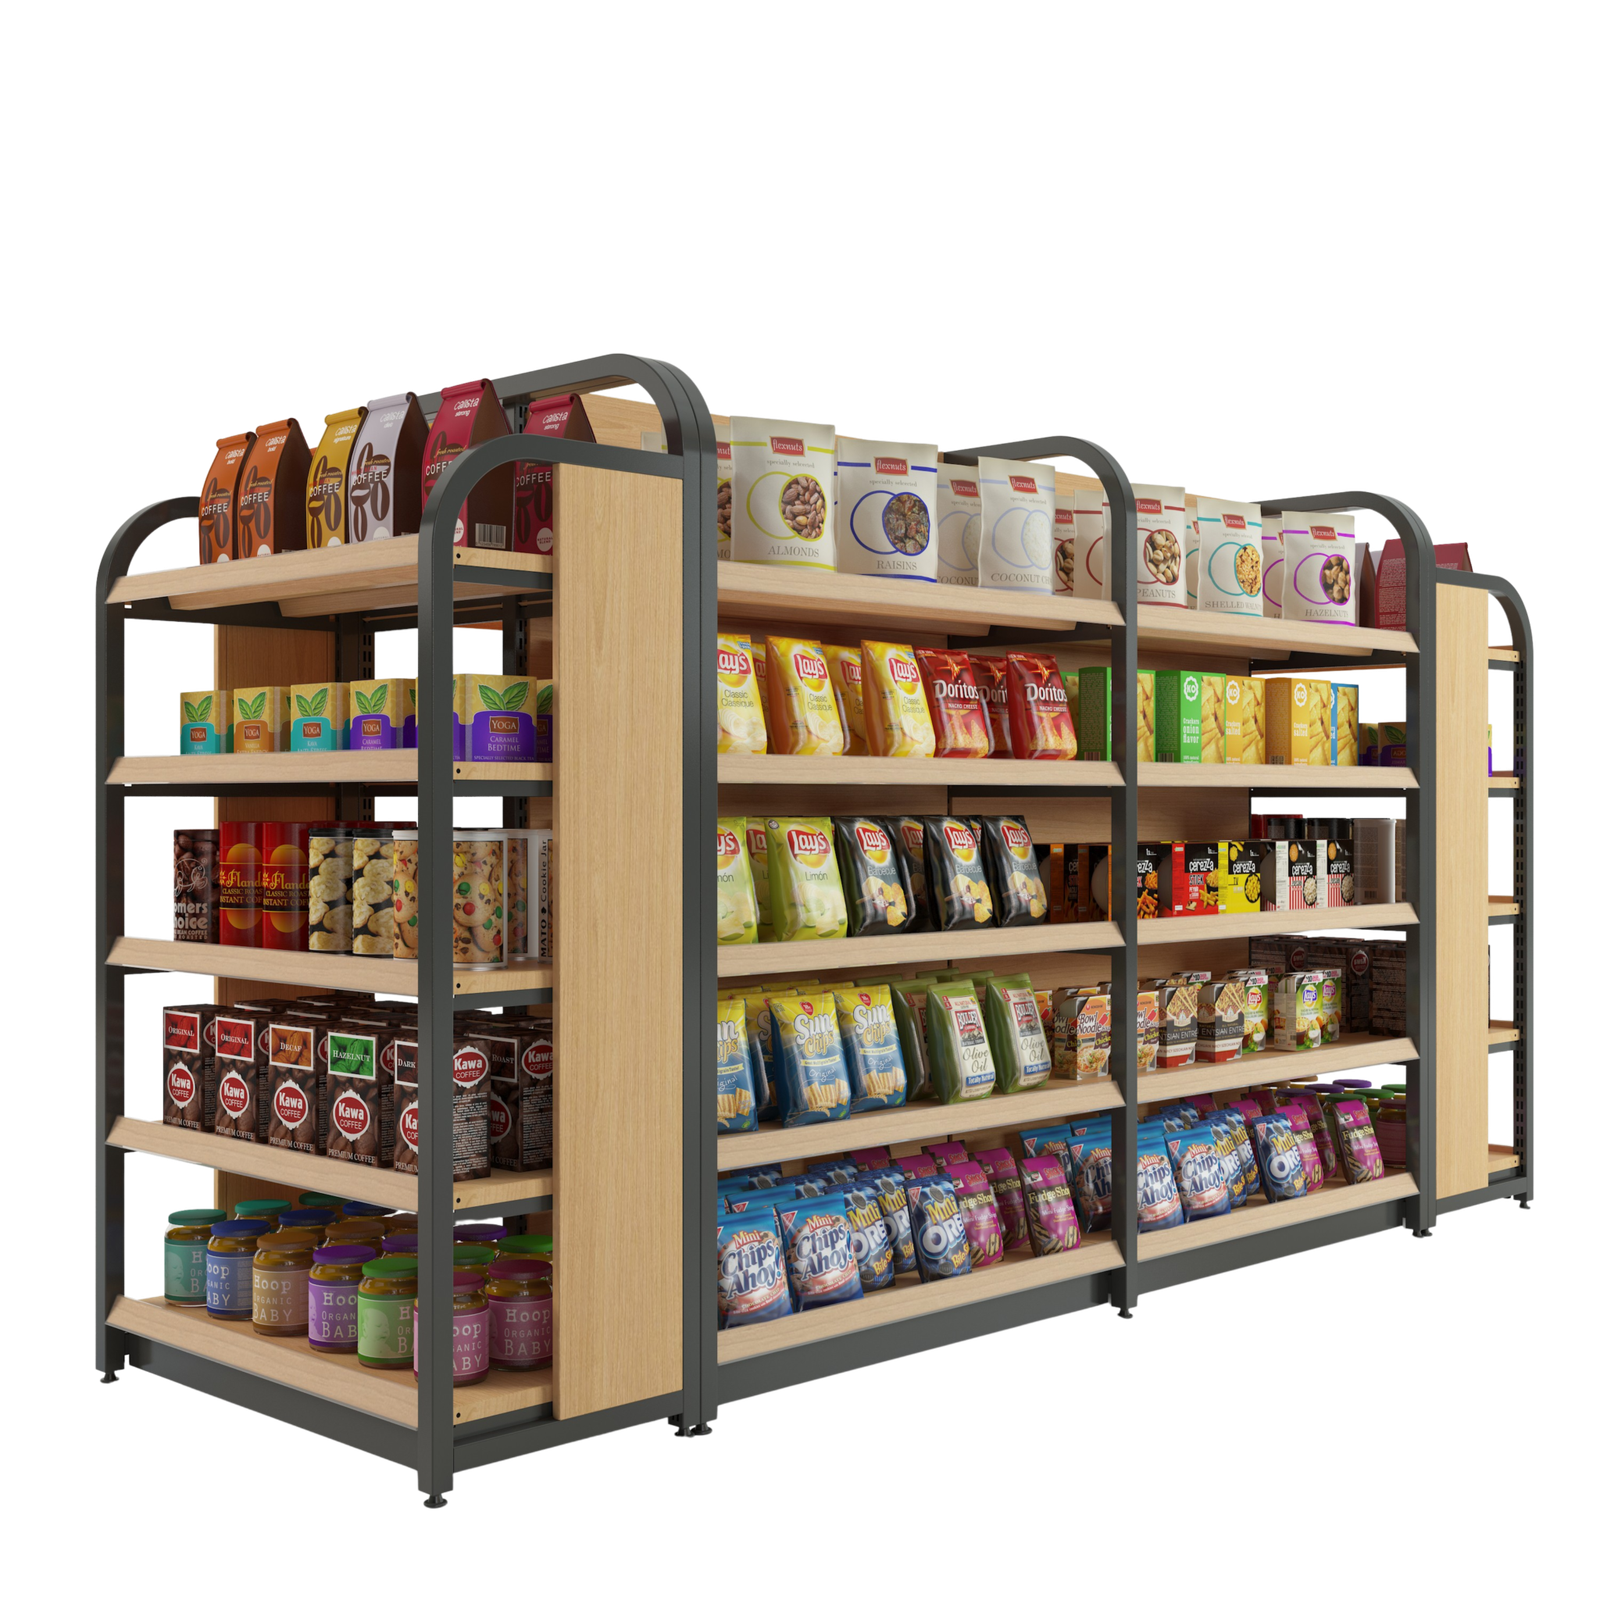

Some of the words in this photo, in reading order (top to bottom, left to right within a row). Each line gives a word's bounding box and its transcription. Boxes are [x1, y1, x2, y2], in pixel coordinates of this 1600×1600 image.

[453, 397, 480, 411] calista
[772, 438, 803, 452] flexnuts
[766, 459, 792, 468] specially
[876, 458, 907, 472] flexnuts
[352, 470, 388, 486] COFFEE
[516, 471, 552, 487] COFFEE
[869, 479, 894, 487] specially
[309, 483, 340, 498] COFFEE
[241, 491, 269, 506] COFFEE
[201, 502, 229, 517] COFFEE
[767, 545, 820, 558] ALMONDS
[877, 560, 918, 571] RAISINS
[990, 573, 1040, 584] COCONUT
[1204, 600, 1245, 610] SHELLED
[795, 654, 825, 680] Lay's
[890, 657, 918, 684] Lay's
[724, 689, 749, 699] Classic
[933, 679, 980, 700] Doritos
[1024, 682, 1068, 703] Doritos
[1186, 684, 1196, 694] KO
[721, 697, 755, 709] Classique
[808, 693, 828, 703] Classic
[903, 696, 920, 706] Classic
[807, 701, 833, 712] Classique
[902, 704, 925, 714] Classique
[244, 726, 261, 738] YOGA
[303, 724, 321, 736] YOGA
[363, 723, 380, 733] YOGA
[491, 719, 517, 731] YOGA
[1183, 724, 1200, 734] onion
[1226, 726, 1241, 736] salted
[1293, 722, 1308, 730] Crackers
[190, 729, 206, 741] YOGA
[490, 735, 519, 743] CARAMEL
[1183, 734, 1200, 744] flavor
[1293, 728, 1308, 737] salted
[487, 743, 521, 752] BEDTIME
[791, 830, 825, 856] Lay's
[858, 827, 887, 851] Lay's
[946, 827, 974, 850] Lay's
[1003, 826, 1029, 849] Lay's
[867, 865, 896, 877] Barbecue
[955, 863, 982, 874] Barbecue
[1012, 861, 1038, 871] Barbecue
[804, 871, 829, 882] Limón
[1189, 874, 1205, 885] STICK
[1303, 989, 1317, 1002] Lay's
[853, 1004, 891, 1035] Sun
[1080, 1011, 1099, 1024] Bowl
[168, 1027, 195, 1037] ORIGINAL
[793, 1013, 835, 1046] Sun
[863, 1021, 892, 1047] Chips
[1077, 1023, 1102, 1036] Noodle
[221, 1034, 249, 1045] ORIGINAL
[804, 1031, 835, 1058] Chips
[1021, 1038, 1044, 1051] Olive
[1095, 1035, 1111, 1046] Chicke
[280, 1042, 303, 1052] DECAF
[963, 1047, 989, 1061] Olive
[332, 1049, 371, 1063] HAZELNUT
[492, 1054, 515, 1065] ROAST
[867, 1054, 894, 1071] Original
[1029, 1049, 1045, 1063] Oil
[397, 1058, 416, 1069] DARK
[454, 1057, 483, 1071] Kawa
[971, 1059, 988, 1074] Oil
[1026, 1064, 1039, 1073] Totally
[455, 1070, 481, 1080] COFFEE
[808, 1065, 837, 1083] Original
[968, 1073, 981, 1085] Totally
[981, 1072, 994, 1082] Natural
[171, 1073, 191, 1090] Kawa
[172, 1089, 190, 1099] COFFEE
[224, 1083, 245, 1100] Kawa
[225, 1098, 244, 1109] COFFEE
[279, 1092, 303, 1110] Kawa
[280, 1108, 301, 1119] COFFEE
[338, 1102, 364, 1121] Kawa
[183, 1120, 201, 1130] COFFEE
[339, 1119, 363, 1130] COFFEE
[216, 1125, 236, 1137] PREMIUM
[236, 1130, 255, 1140] COFFEE
[1342, 1129, 1362, 1141] Fudge
[270, 1137, 293, 1149] PREMIUM
[293, 1142, 314, 1152] COFFEE
[1044, 1140, 1066, 1154] Mini
[1271, 1131, 1296, 1156] Mini
[328, 1148, 354, 1161] PREMIUM
[354, 1153, 376, 1165] COFFEE
[1090, 1147, 1112, 1162] Mini
[1187, 1143, 1208, 1159] Mini
[1139, 1154, 1160, 1169] Mini
[1182, 1150, 1218, 1181] Chips
[1137, 1161, 1171, 1191] Chips
[1187, 1167, 1224, 1198] Ahoy!
[877, 1187, 907, 1215] Mini
[1028, 1189, 1056, 1205] Fudge
[1138, 1177, 1177, 1211] Ahoy!
[846, 1199, 882, 1232] Mini
[925, 1193, 959, 1226] Mini
[805, 1214, 834, 1233] Mini
[732, 1230, 762, 1250] Mini
[796, 1224, 847, 1260] Chips
[722, 1240, 775, 1279] Chips
[801, 1229, 854, 1282] Ahoy!
[951, 1250, 967, 1269] Bite
[727, 1245, 782, 1300] Ahoy!
[872, 1257, 888, 1276] Bite
[254, 1275, 292, 1295] Hoop
[322, 1292, 357, 1306] Hoo
[742, 1292, 770, 1310] CHOCOLATE
[253, 1303, 293, 1322] BABY
[321, 1310, 357, 1321] ORGAN
[505, 1308, 551, 1324] Hoop
[321, 1321, 358, 1338] BAB
[504, 1326, 551, 1338] ORGANIC
[504, 1339, 551, 1356] BABY
